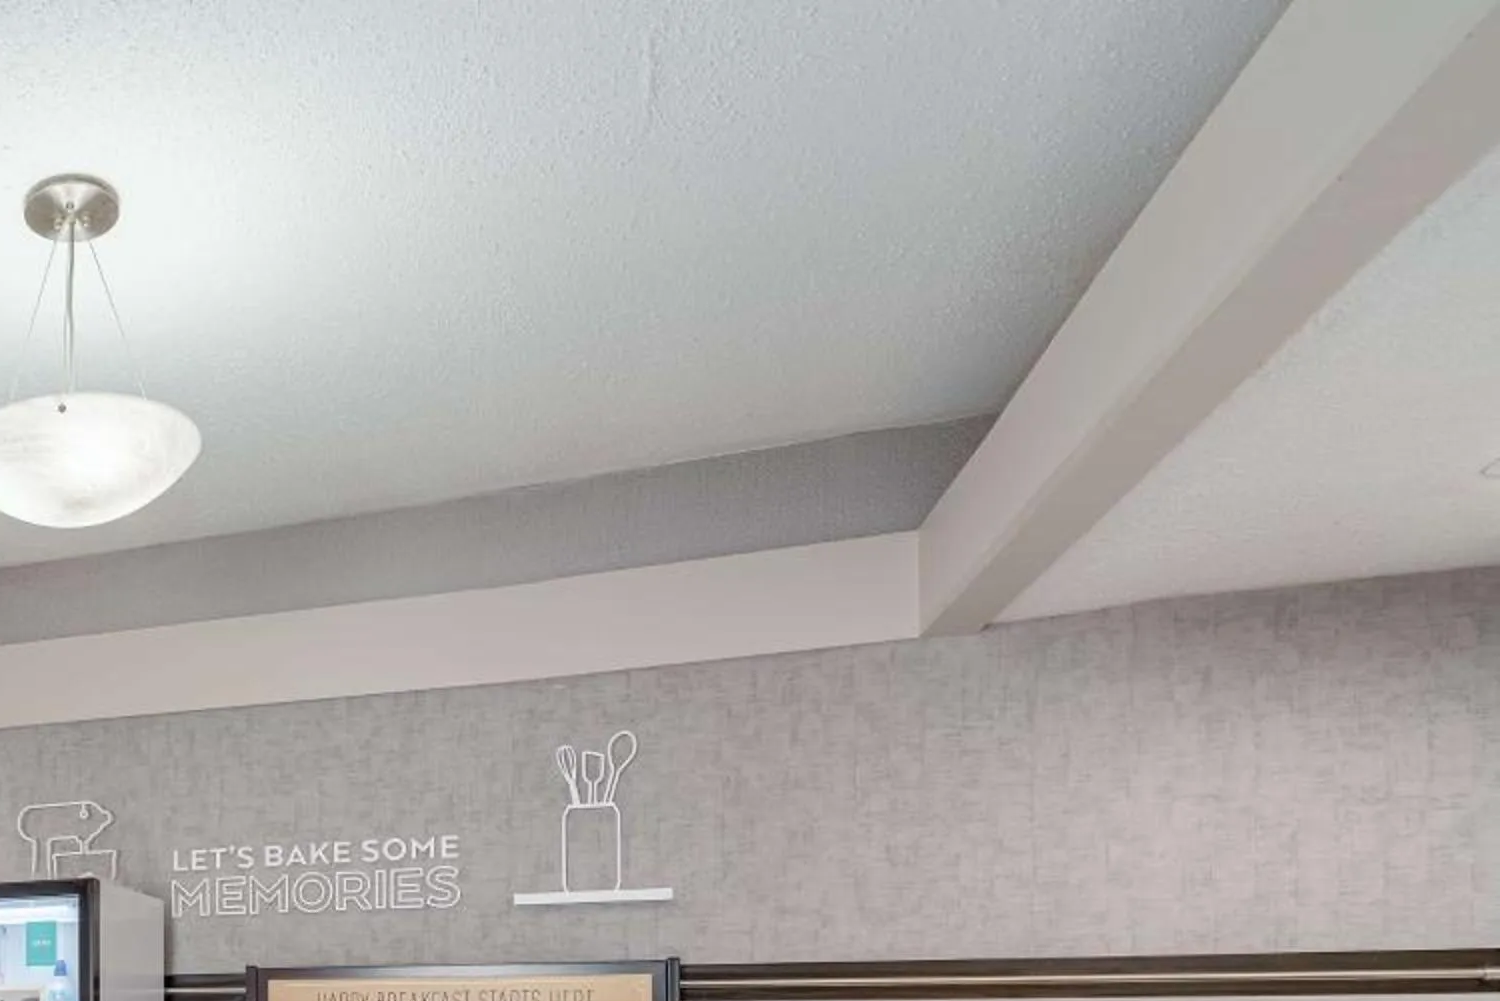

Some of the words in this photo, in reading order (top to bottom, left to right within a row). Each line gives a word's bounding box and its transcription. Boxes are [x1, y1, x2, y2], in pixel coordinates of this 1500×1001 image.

[172, 844, 255, 872] LET'S
[263, 841, 353, 868] BAKE
[360, 834, 461, 864] SOME
[170, 865, 462, 919] MEMORIES
